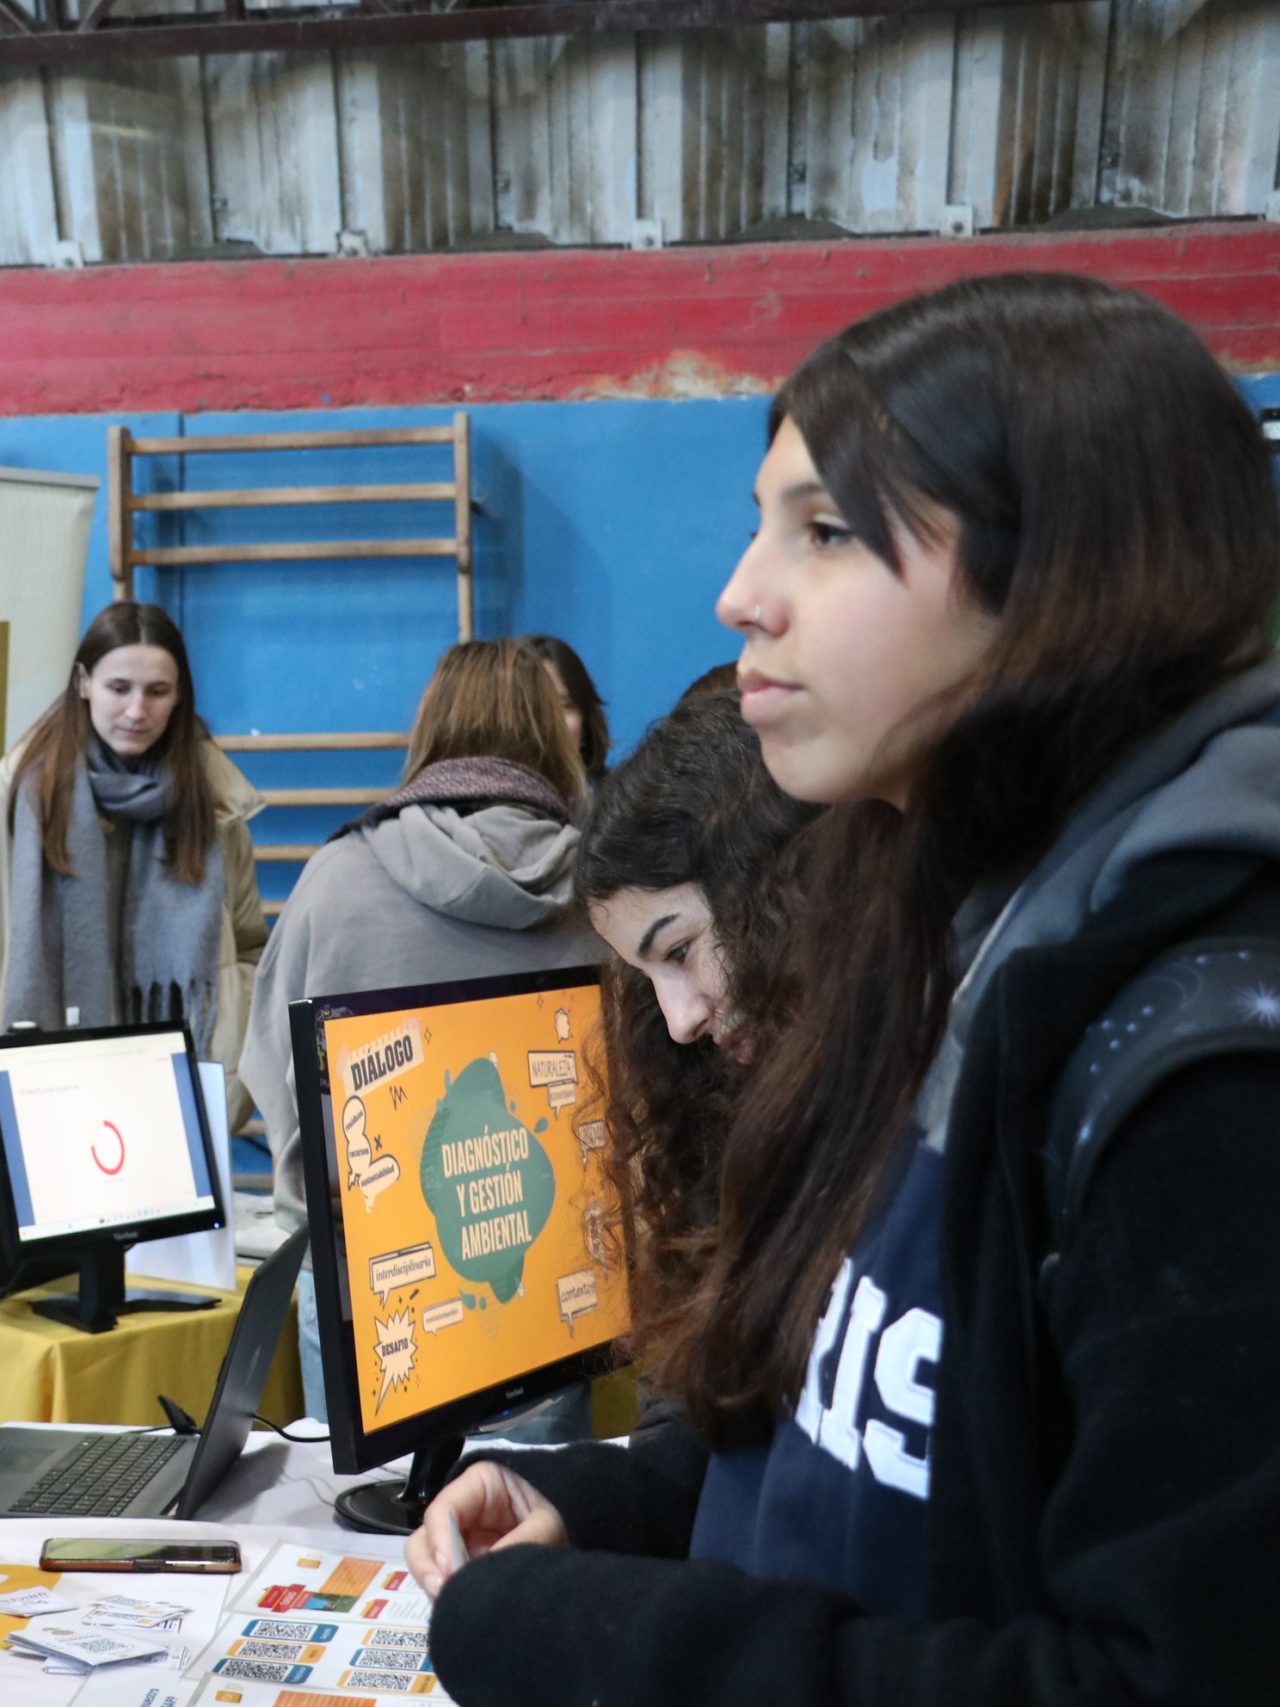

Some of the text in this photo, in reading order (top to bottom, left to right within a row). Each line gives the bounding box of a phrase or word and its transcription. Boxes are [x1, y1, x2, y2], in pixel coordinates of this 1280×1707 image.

[350, 1033, 414, 1092] DIÁLOGO
[441, 1124, 530, 1179] DIAGNÓSTICO
[455, 1161, 524, 1217] Y GESTIÓN
[461, 1209, 533, 1261] AMBIENTAL
[375, 1255, 432, 1282] interdisciplinaria
